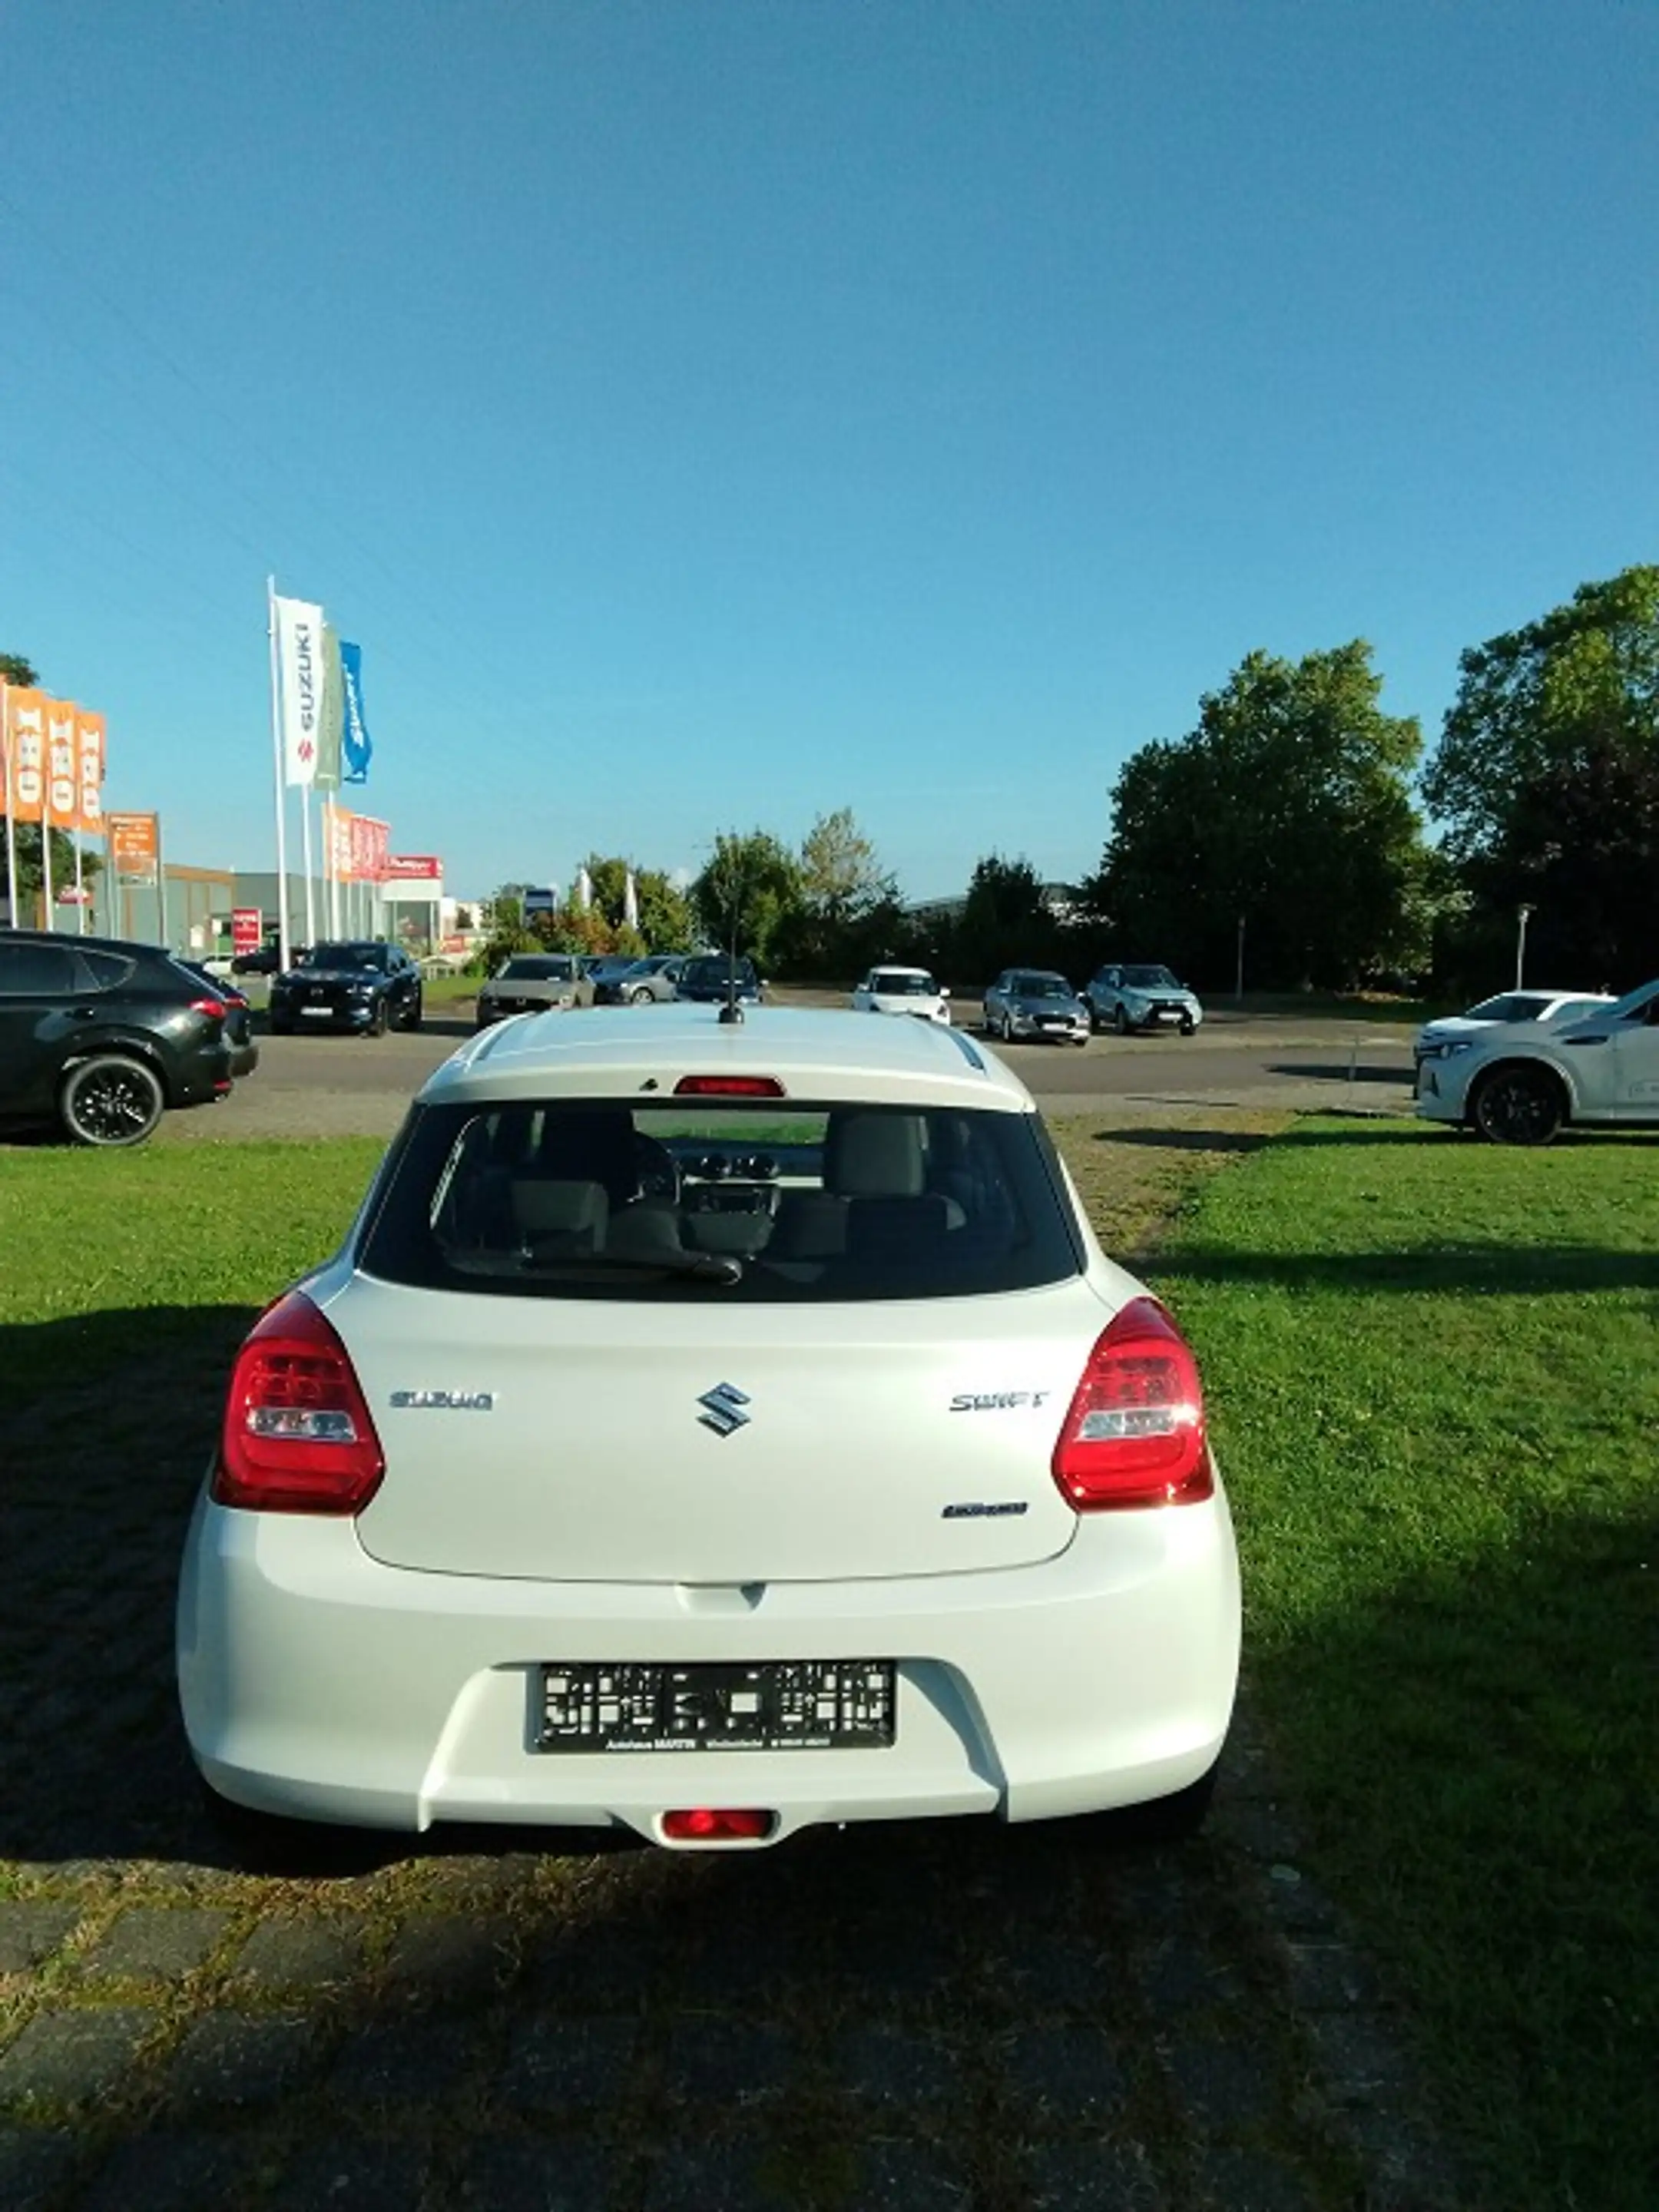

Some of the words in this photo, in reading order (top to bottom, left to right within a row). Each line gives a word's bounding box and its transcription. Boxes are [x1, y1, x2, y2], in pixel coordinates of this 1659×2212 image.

[295, 624, 315, 731] SUZUKI
[17, 707, 41, 803] OBI
[49, 717, 75, 813] OBI
[949, 1392, 1051, 1411] SWIFT
